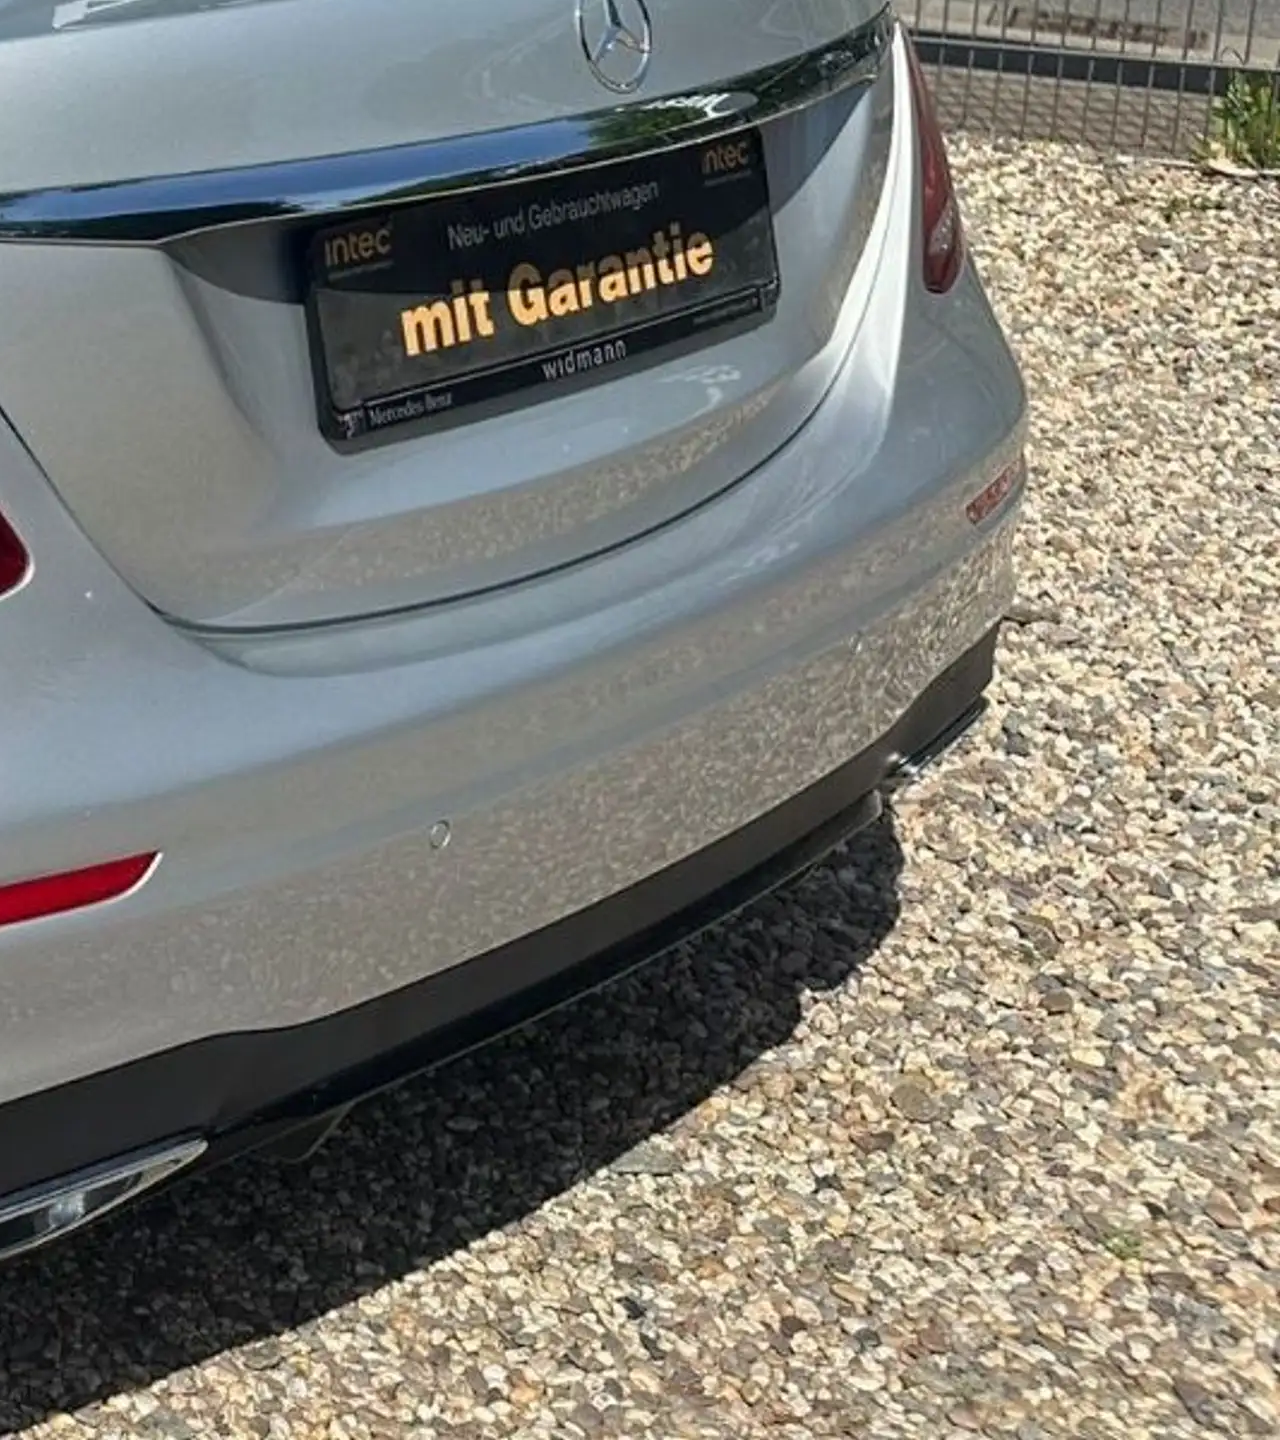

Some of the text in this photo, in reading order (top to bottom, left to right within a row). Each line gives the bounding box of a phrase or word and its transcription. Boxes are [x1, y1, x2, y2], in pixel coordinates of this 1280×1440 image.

[448, 180, 659, 251] Neu- und Gebrauchtwagen
[400, 220, 714, 357] mit Garantie
[541, 338, 628, 381] widmann
